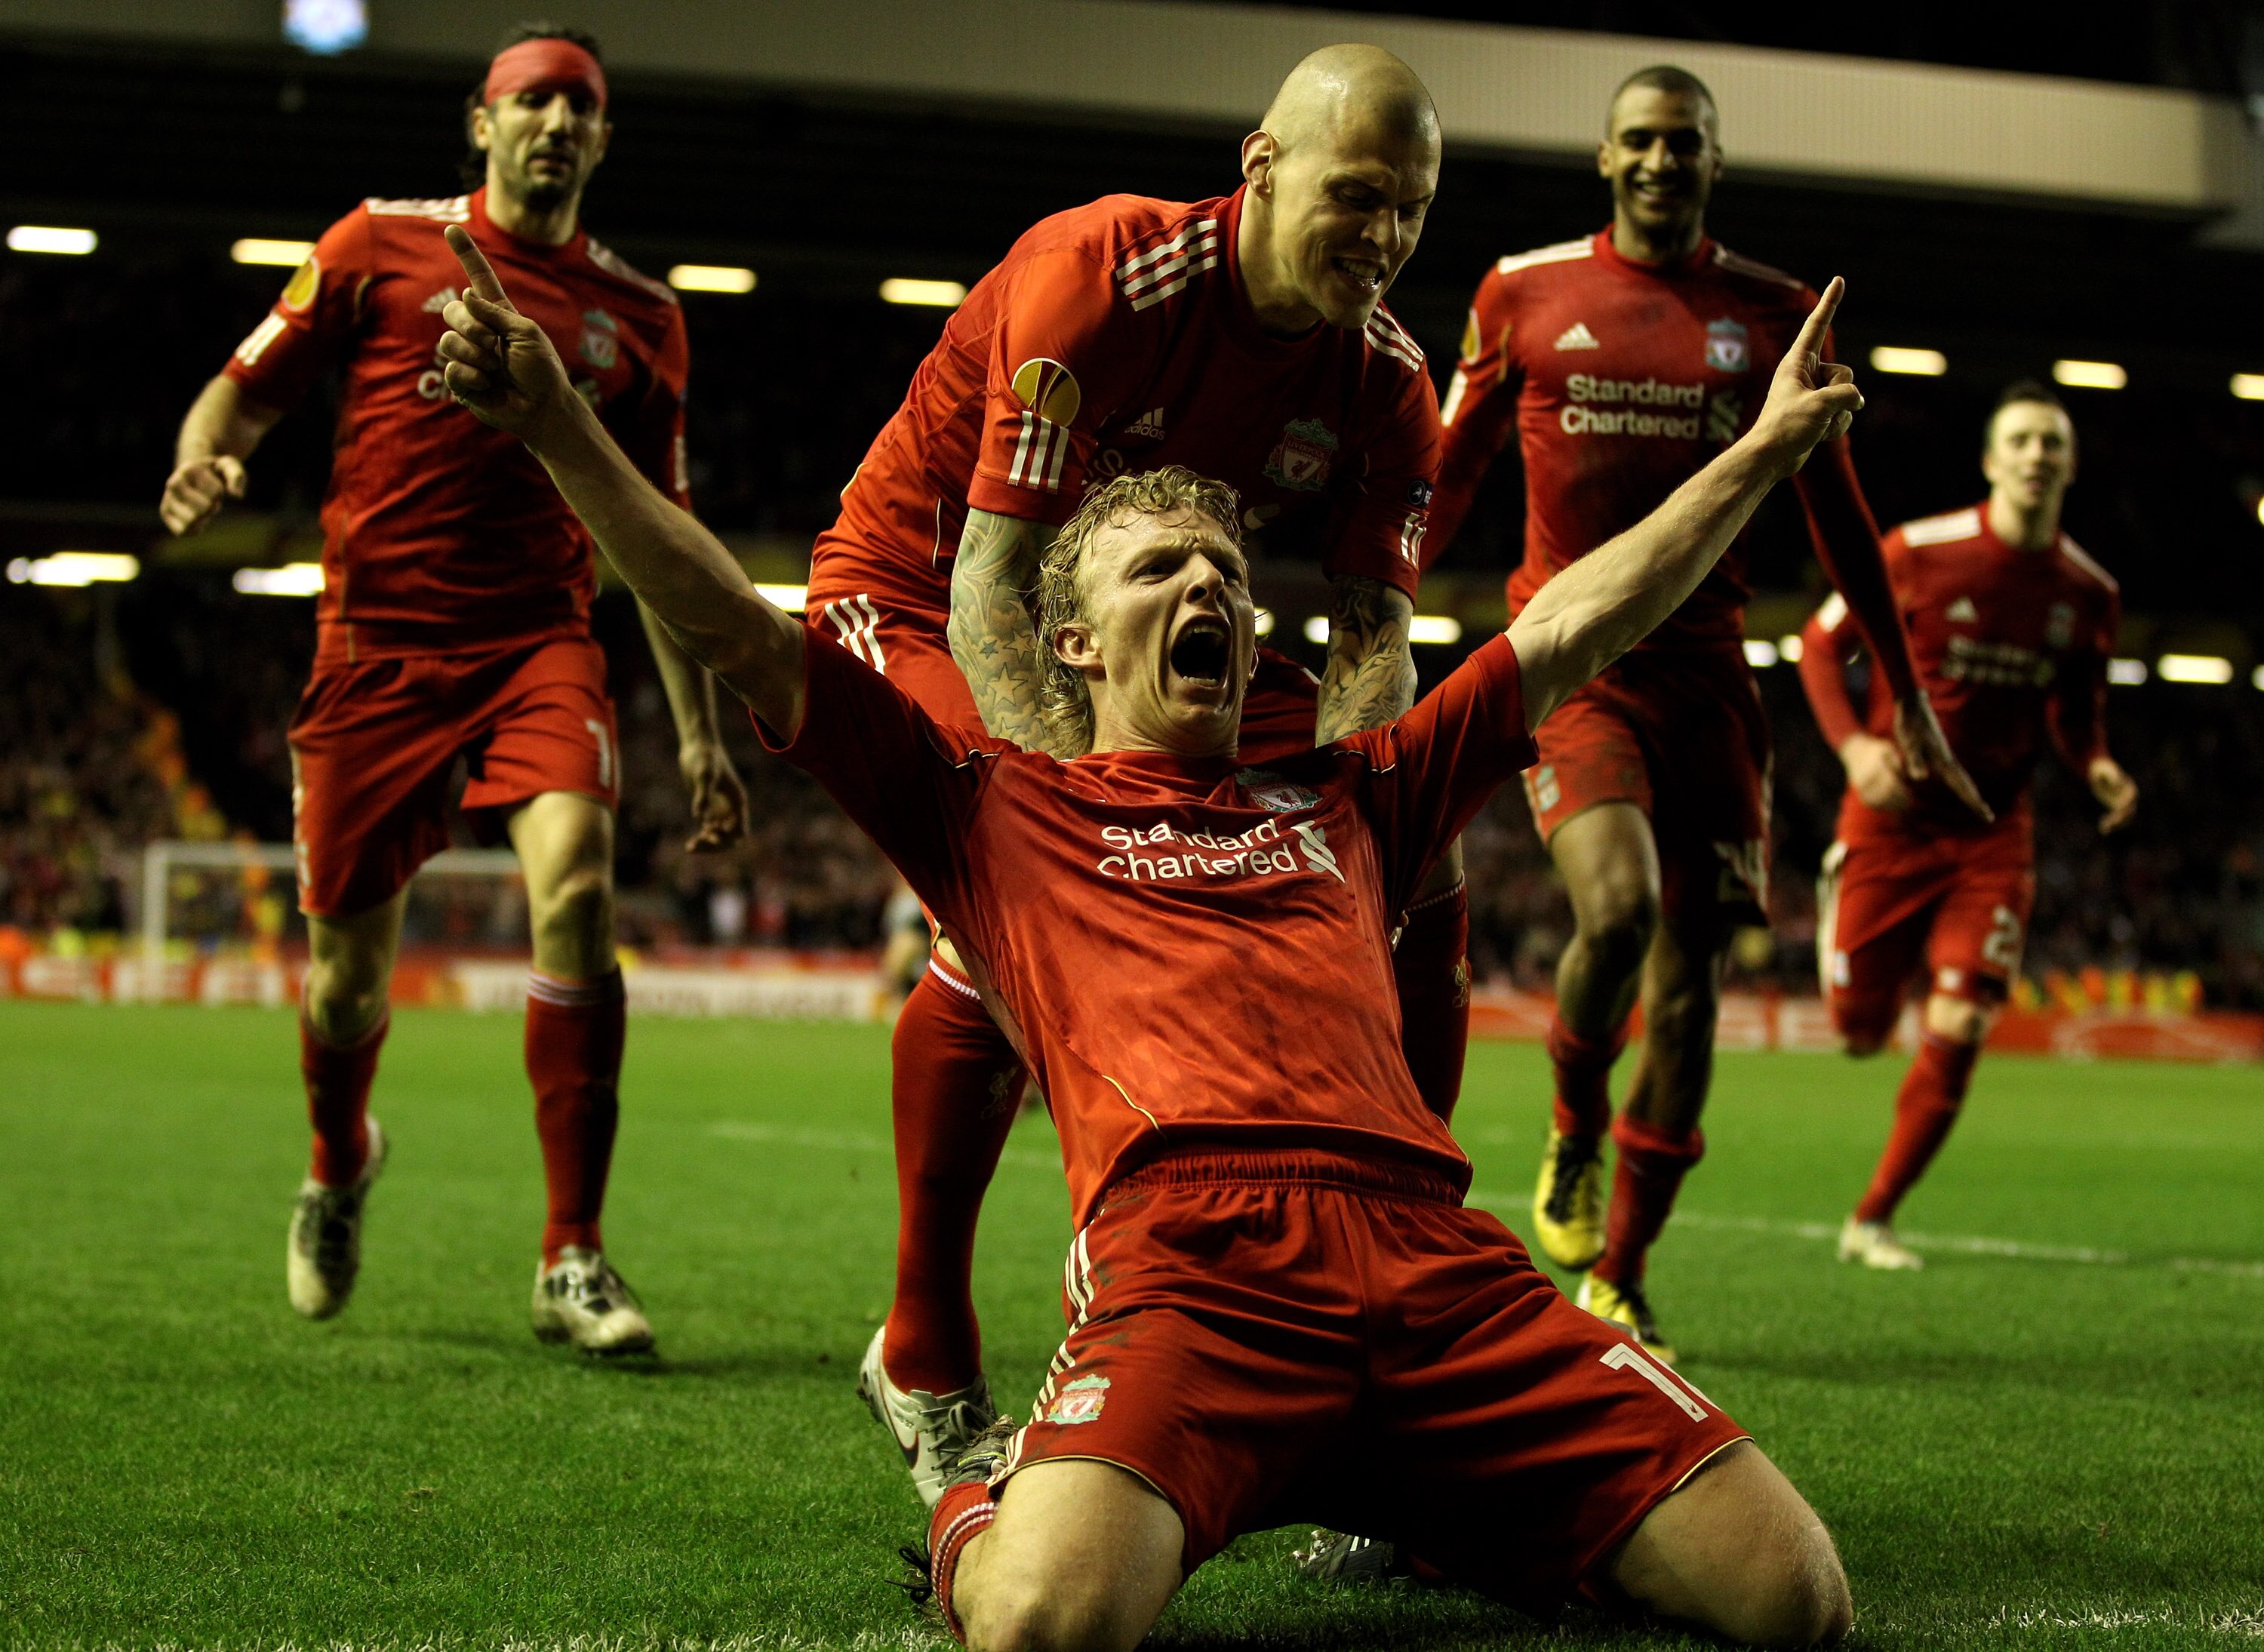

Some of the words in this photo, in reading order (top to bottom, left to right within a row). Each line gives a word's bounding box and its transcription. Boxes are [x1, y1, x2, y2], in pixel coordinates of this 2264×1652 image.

[1566, 373, 1704, 408] Standard
[1559, 404, 1700, 440] Chartered
[1100, 818, 1281, 851] Standard
[1097, 842, 1299, 881] Chartered
[1598, 1341, 1724, 1423] 1
